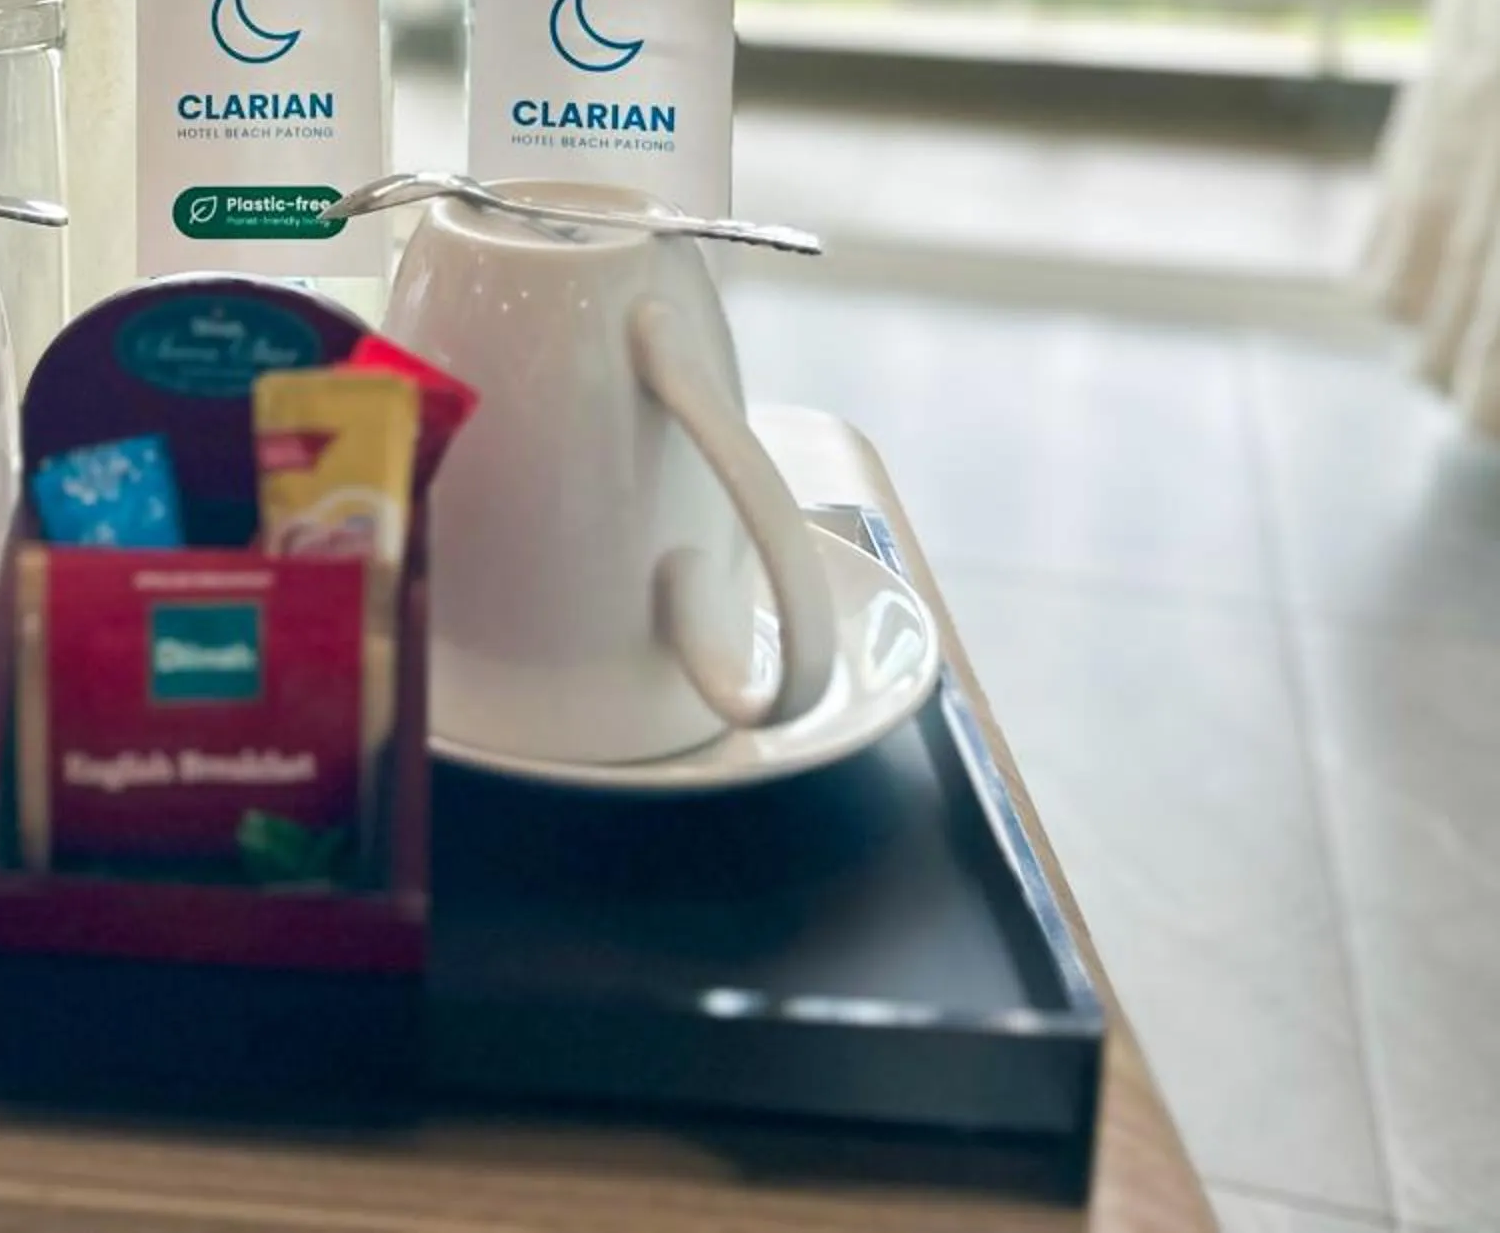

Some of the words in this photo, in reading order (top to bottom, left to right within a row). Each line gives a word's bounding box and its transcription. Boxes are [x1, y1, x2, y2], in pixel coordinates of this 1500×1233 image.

[177, 92, 334, 120] CLARIAN
[512, 100, 676, 133] CLARIAN
[177, 127, 220, 139] HOTEL
[225, 127, 271, 139] BEACH
[275, 126, 334, 138] PATONG
[511, 134, 554, 147] HOTEL
[561, 135, 609, 149] BEACH
[615, 138, 676, 152] PATONG
[226, 195, 332, 212] Plastic-free
